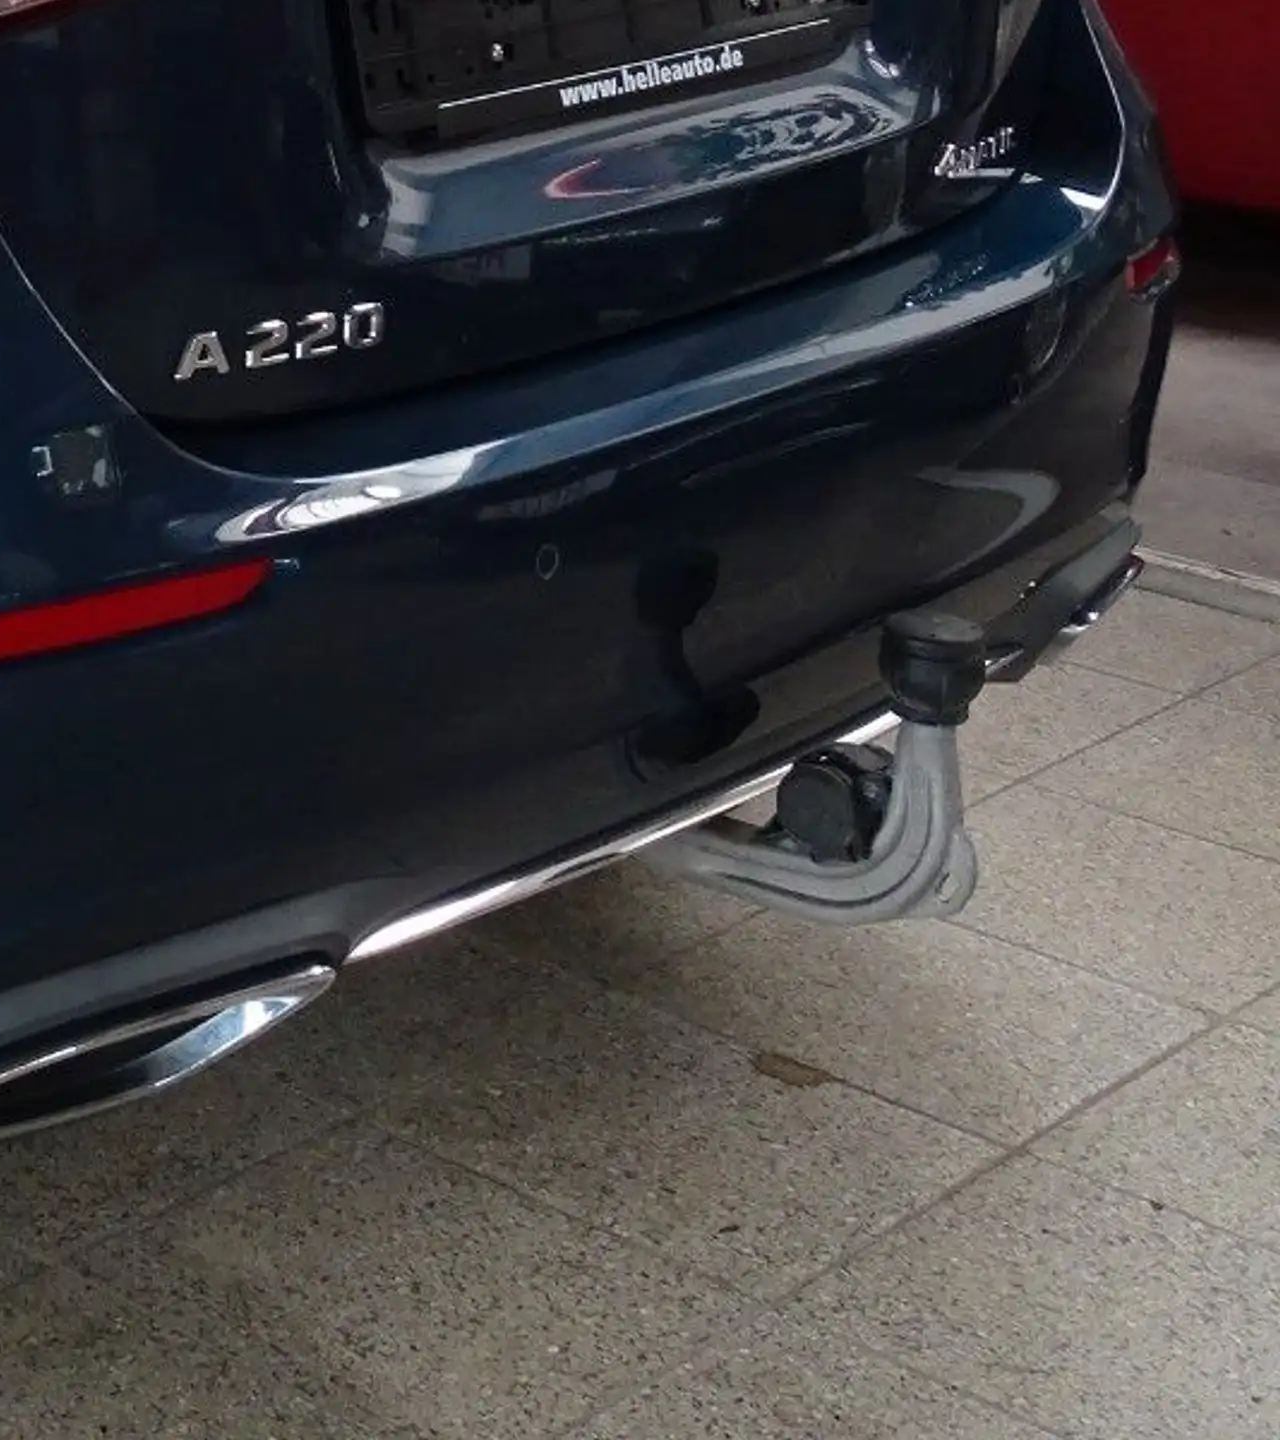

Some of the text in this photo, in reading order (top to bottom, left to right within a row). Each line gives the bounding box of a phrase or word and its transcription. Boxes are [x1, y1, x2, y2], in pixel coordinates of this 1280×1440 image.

[559, 45, 744, 107] www.helleauto.de
[173, 302, 385, 380] A 220
